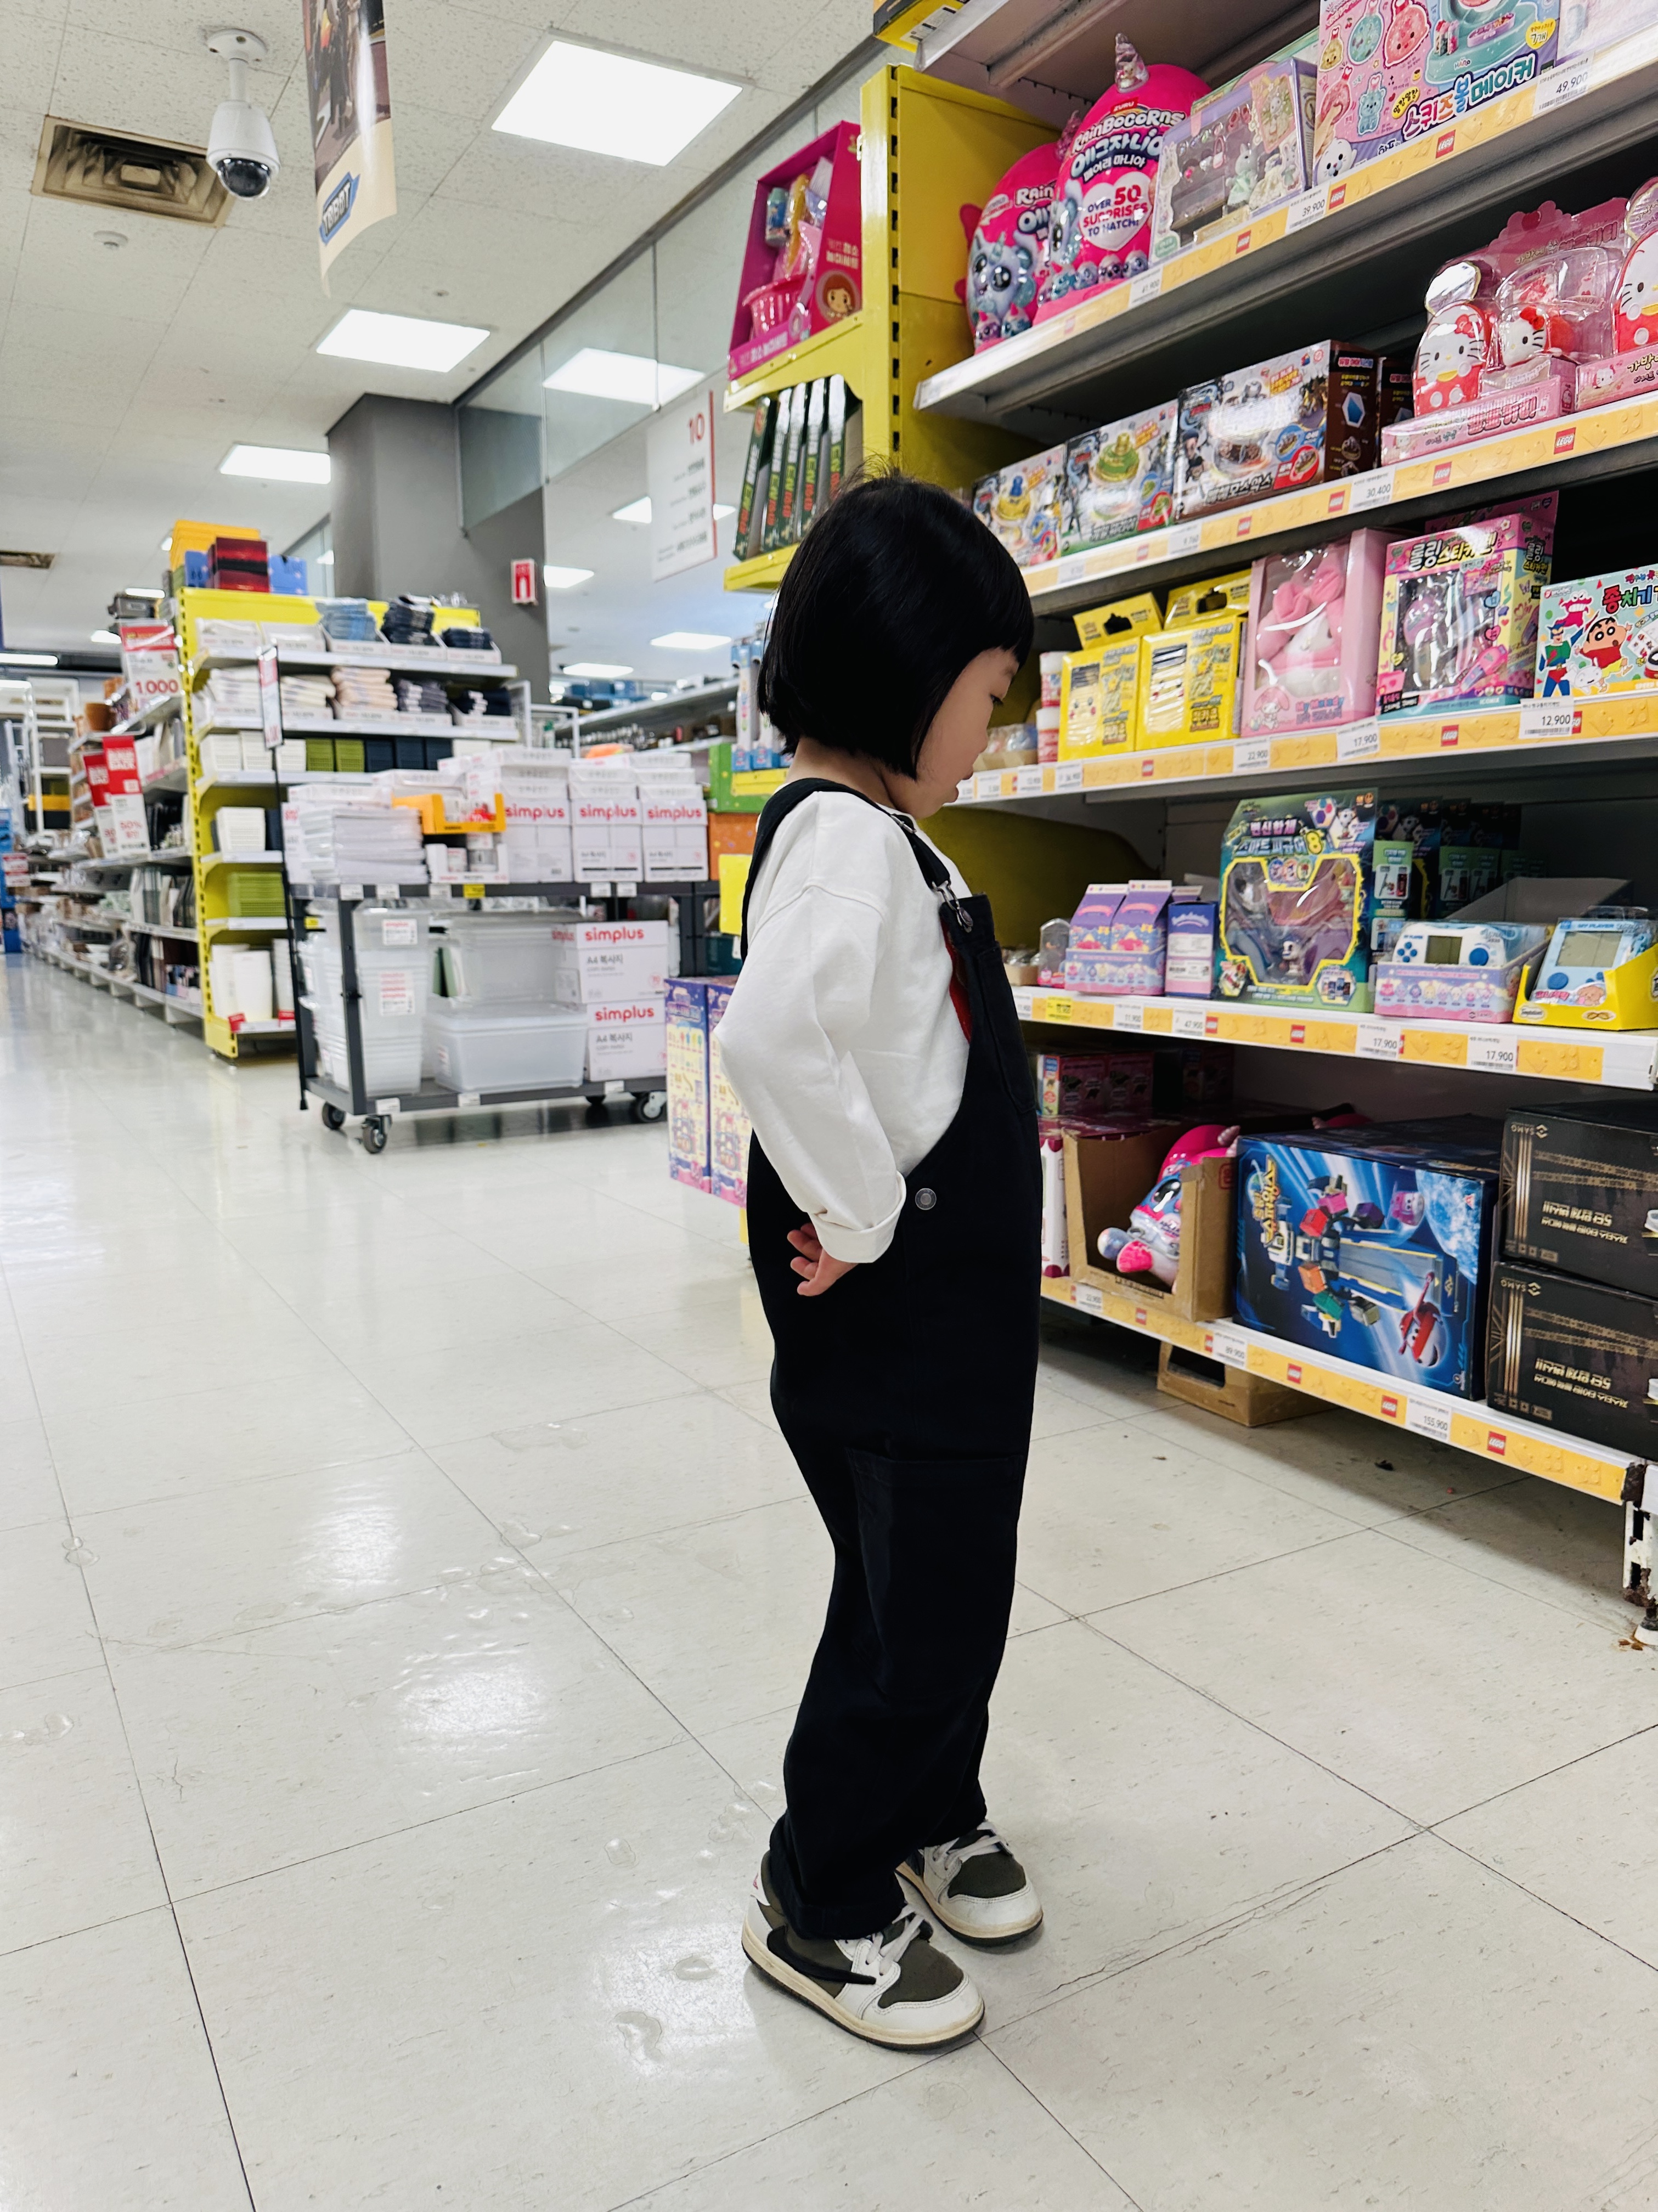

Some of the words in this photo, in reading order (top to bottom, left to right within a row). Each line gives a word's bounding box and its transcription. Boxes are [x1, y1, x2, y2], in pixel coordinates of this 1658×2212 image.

[1471, 56, 1533, 103] 메이커
[1556, 72, 1588, 93] 49,900
[1113, 101, 1135, 111] ZURU
[1438, 137, 1454, 151] LEGO
[1087, 197, 1111, 213] OVER
[1114, 184, 1141, 205] 50
[1083, 202, 1148, 228] SURPRISES
[1302, 199, 1326, 217] 39,900
[1088, 225, 1100, 237] TO
[687, 413, 706, 445] 10
[1556, 433, 1574, 447] LEGO
[1434, 468, 1450, 480] LEGO
[1367, 483, 1391, 499] 30,400
[1525, 541, 1544, 562] 롤링
[1601, 584, 1653, 615] 종치기
[1541, 714, 1571, 726] 12,900
[1442, 731, 1458, 740] LEGO
[579, 804, 638, 820] simplus
[647, 805, 702, 821] simplus
[1305, 831, 1322, 854] 8
[585, 927, 644, 944] simplus
[595, 1004, 655, 1022] simplus
[1373, 1037, 1397, 1049] 17,900
[1486, 1050, 1514, 1062] 17,900
[1423, 1415, 1448, 1431] 155,900
[1488, 1438, 1505, 1449] LEGO
